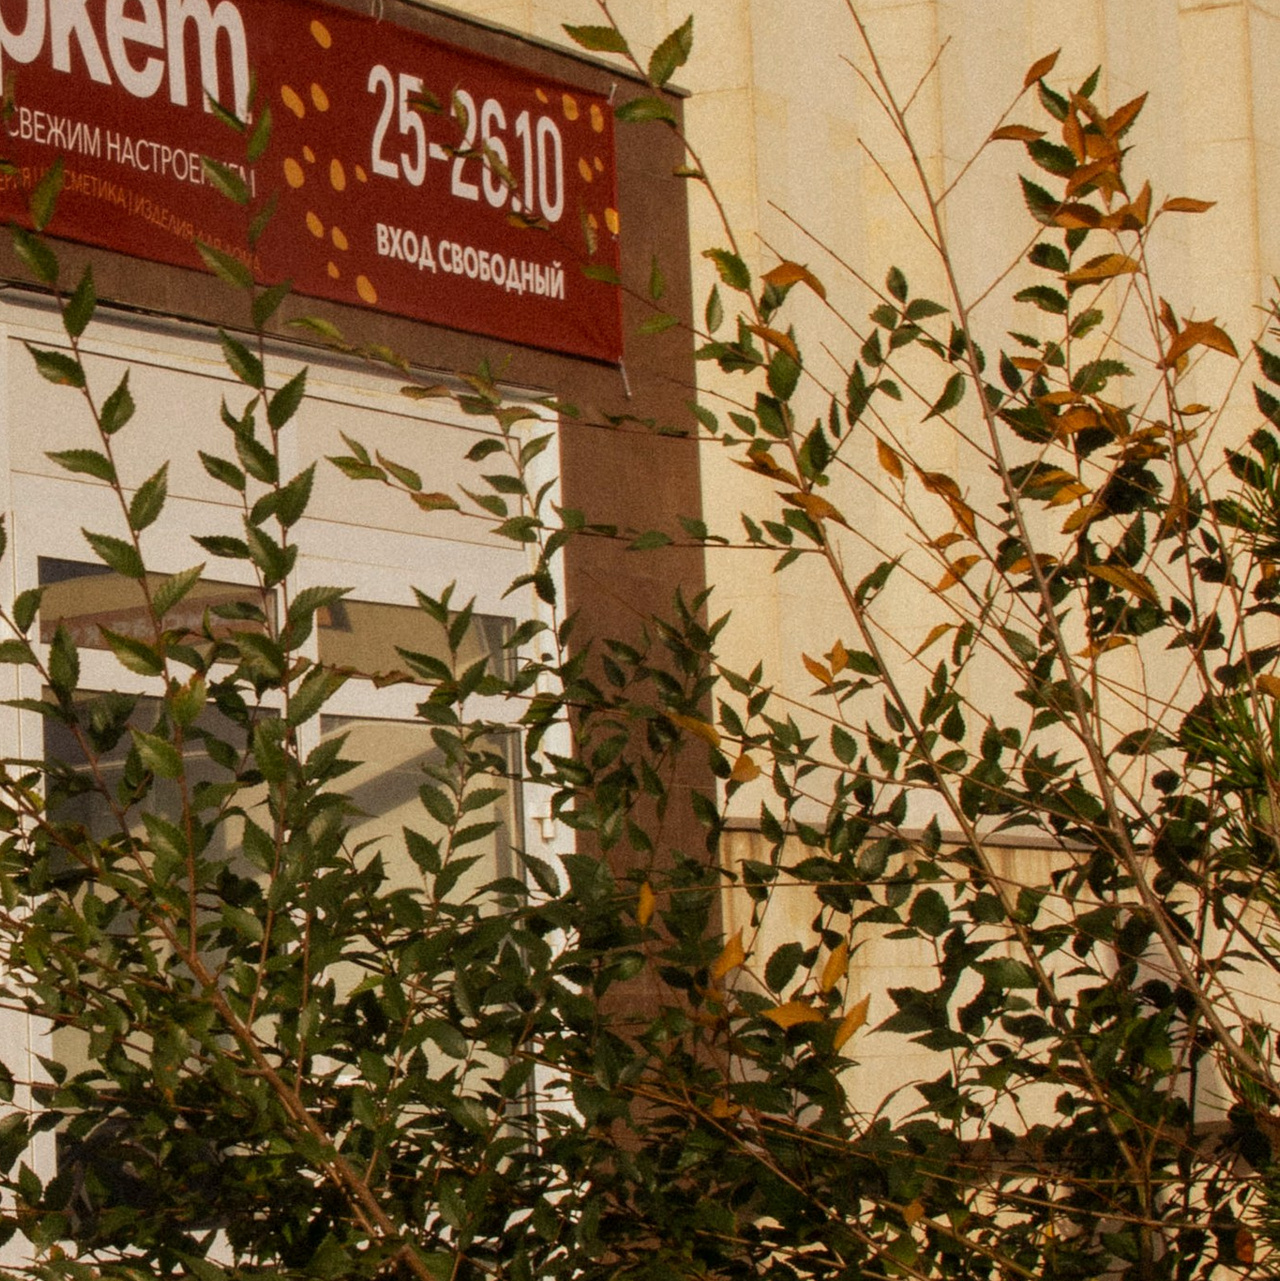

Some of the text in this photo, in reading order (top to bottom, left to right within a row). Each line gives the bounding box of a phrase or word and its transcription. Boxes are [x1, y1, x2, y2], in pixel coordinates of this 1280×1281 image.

[367, 65, 565, 222] 25-26.10
[40, 167, 126, 208] СМЕТИКА
[376, 223, 565, 299] ВХОД СВОБОДНЫЙ
